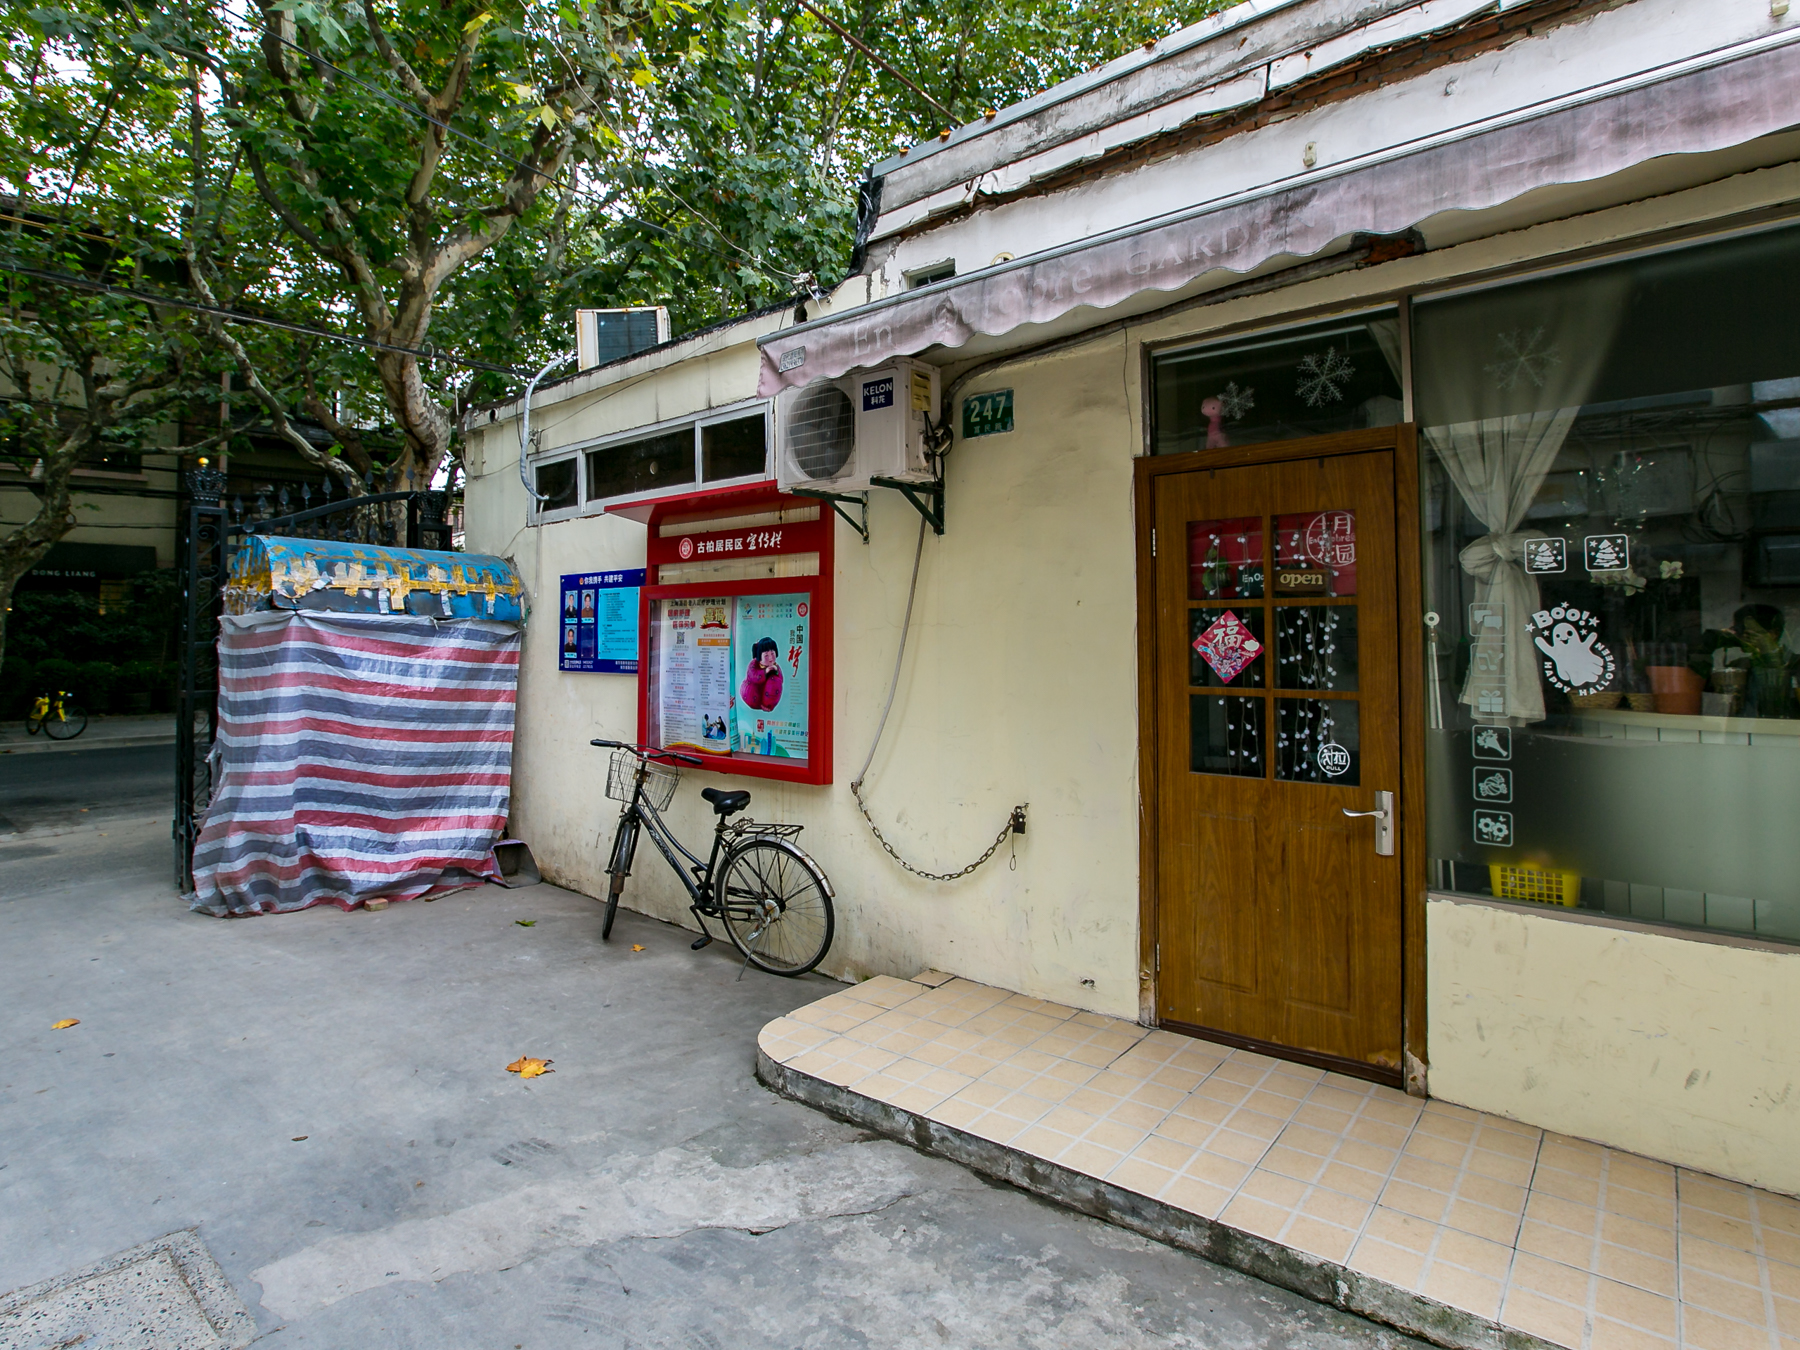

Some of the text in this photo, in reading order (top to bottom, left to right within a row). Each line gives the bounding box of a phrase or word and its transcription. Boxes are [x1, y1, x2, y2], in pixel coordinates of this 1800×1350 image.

[853, 322, 893, 357] En
[863, 382, 893, 397] KELON
[870, 394, 886, 406] 科龙
[970, 395, 1006, 423] 247
[697, 538, 744, 554] 古柏居民区
[746, 530, 783, 551] 宣传栏
[31, 569, 96, 578] DONG LIANG
[1279, 573, 1324, 588] open
[705, 607, 725, 622] 喜报
[1531, 606, 1591, 629] BOO!
[796, 624, 804, 644] 中国
[1213, 618, 1243, 649] 福
[1543, 641, 1616, 697] HAPPY HALLOWEEN
